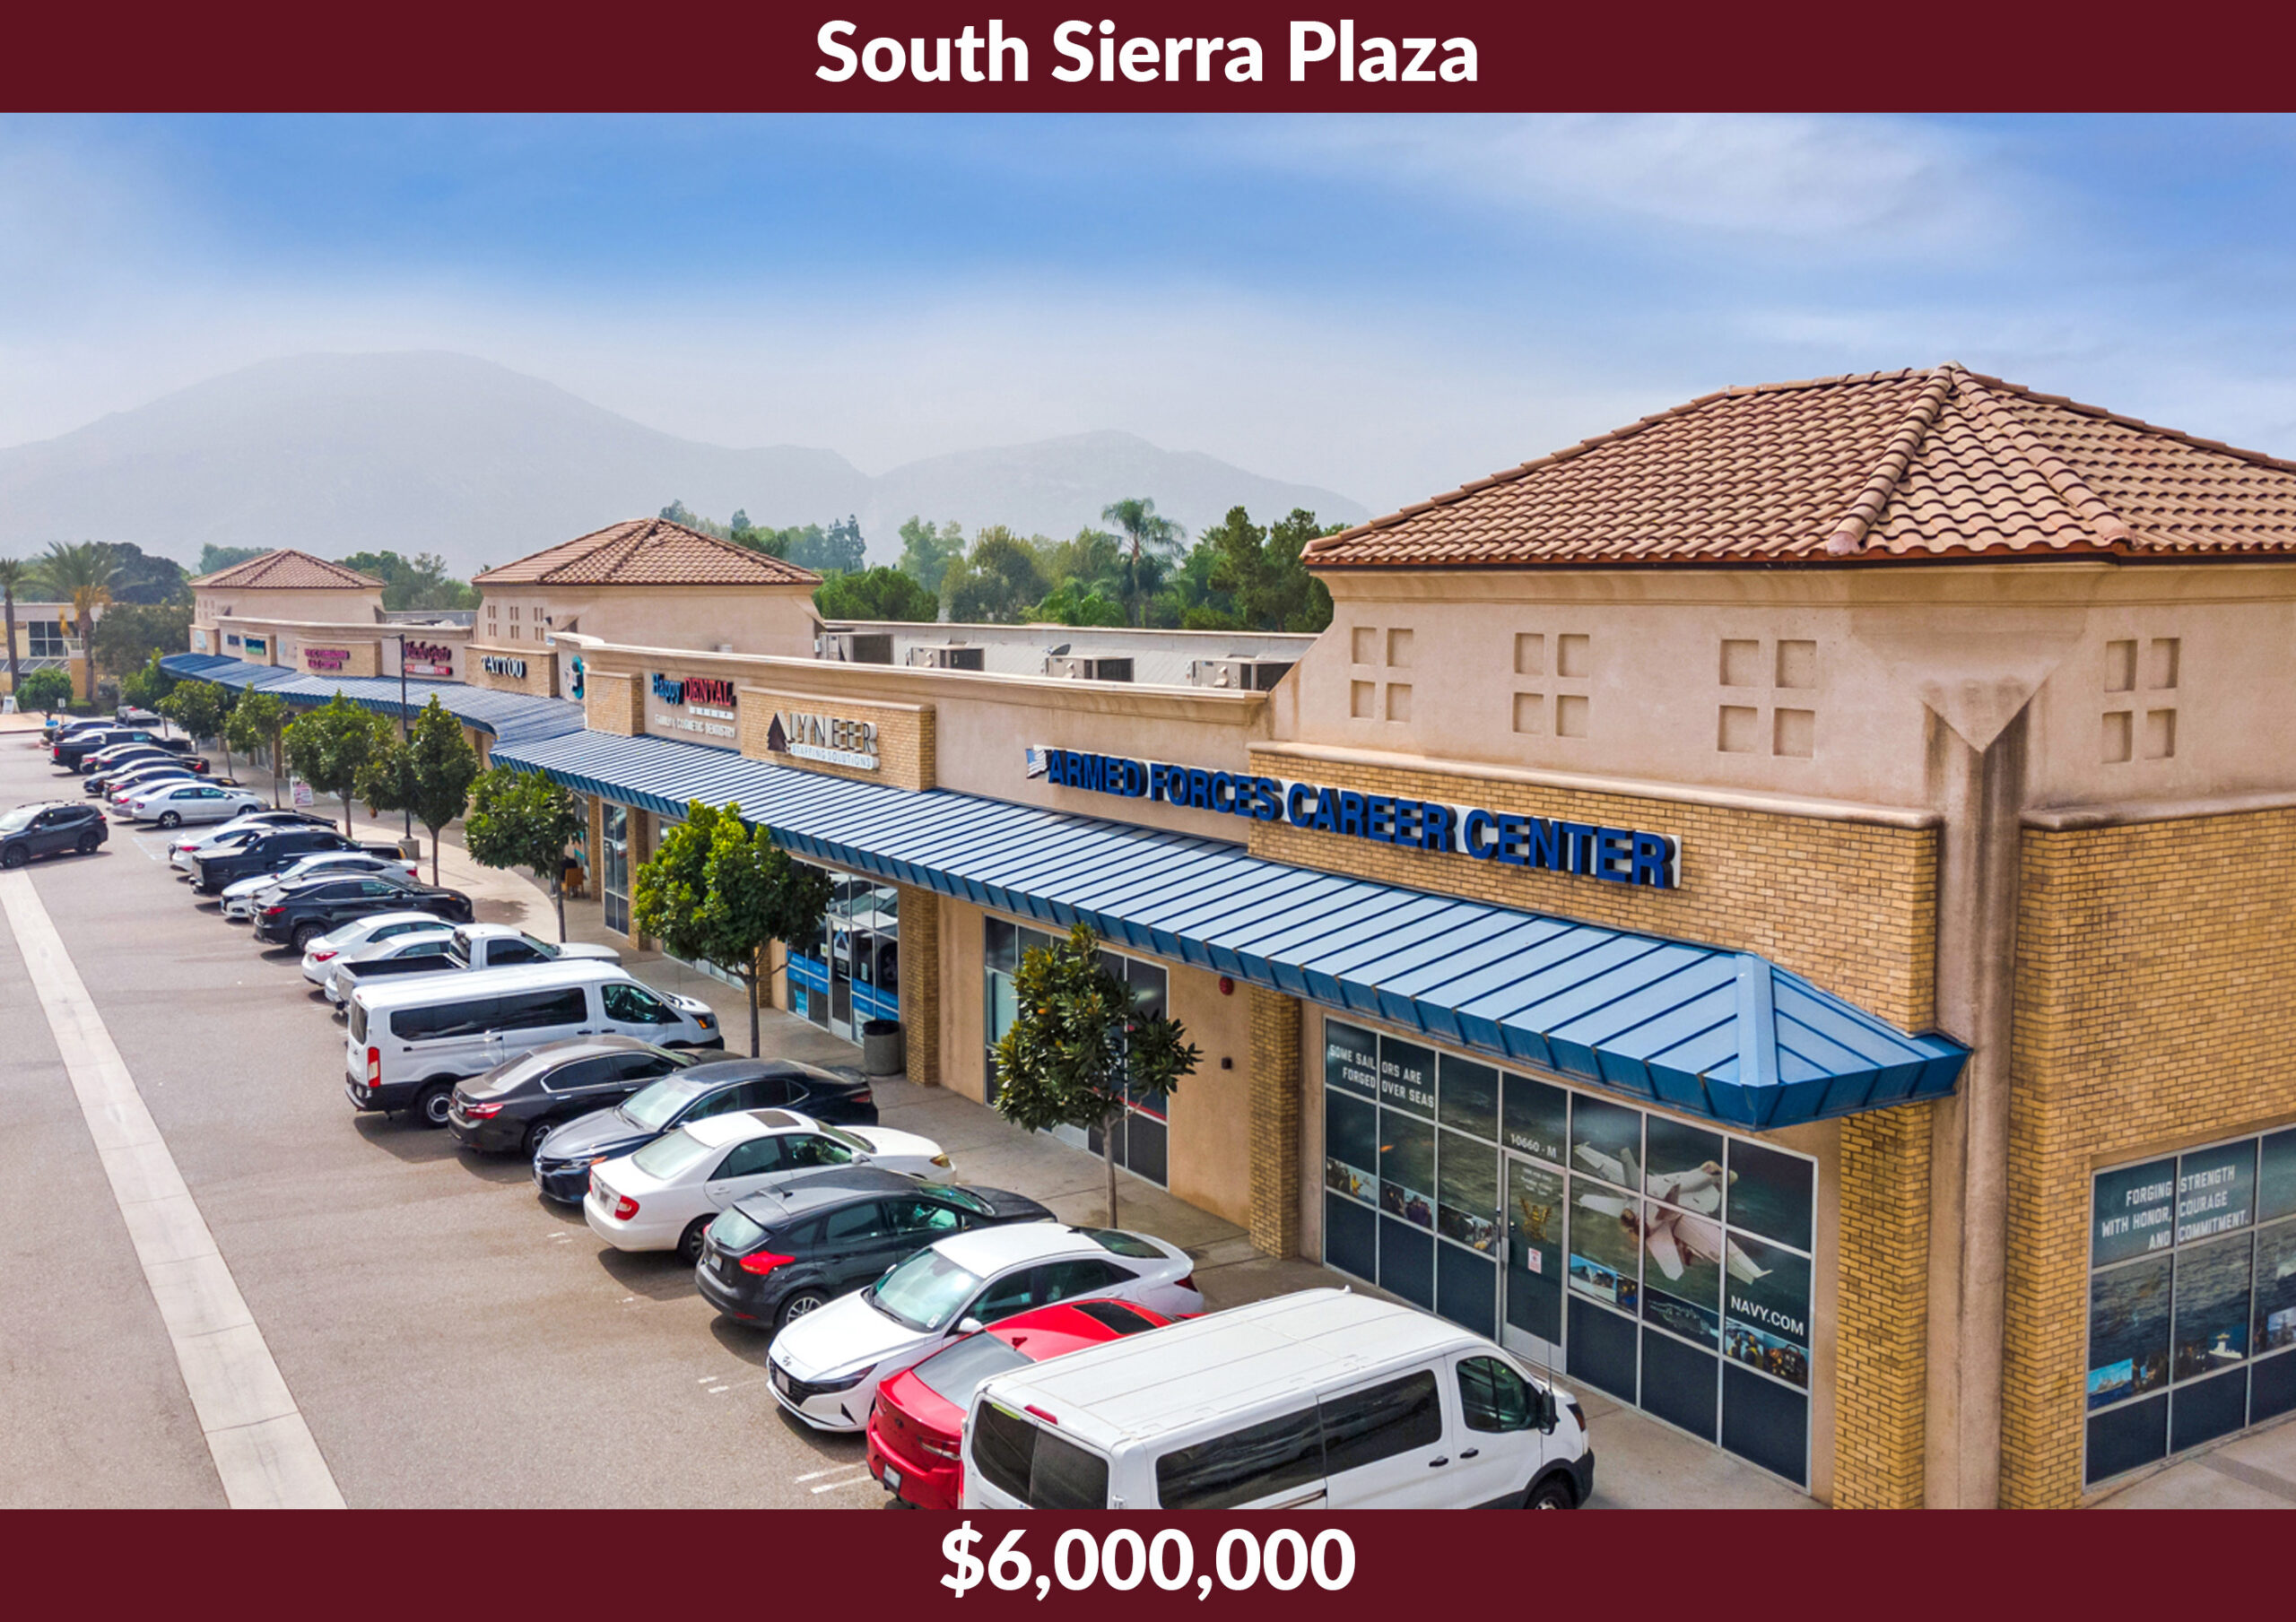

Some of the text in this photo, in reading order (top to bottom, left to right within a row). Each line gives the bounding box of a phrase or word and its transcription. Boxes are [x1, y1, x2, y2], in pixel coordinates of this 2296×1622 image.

[482, 655, 524, 678] TATTOO
[652, 673, 682, 705] Happy
[789, 713, 878, 754] LYNEER
[827, 750, 872, 768] SOLUTIONS
[1048, 750, 1677, 889] ARMED FORCES CAREER CENTER
[1329, 1044, 1352, 1063] SOME
[1403, 1068, 1422, 1085] ARE
[1343, 1066, 1434, 1108] FORGED OVER SEAS
[1510, 1132, 1540, 1153] 10660
[1547, 1145, 1557, 1159] M
[2126, 1166, 2236, 1207] FORGING STRENGTH
[2102, 1191, 2228, 1237] WITH HONOR, COURAGE
[2148, 1210, 2249, 1251] AND COMMITMENT.
[1731, 1295, 1805, 1337] NAVY.COM
